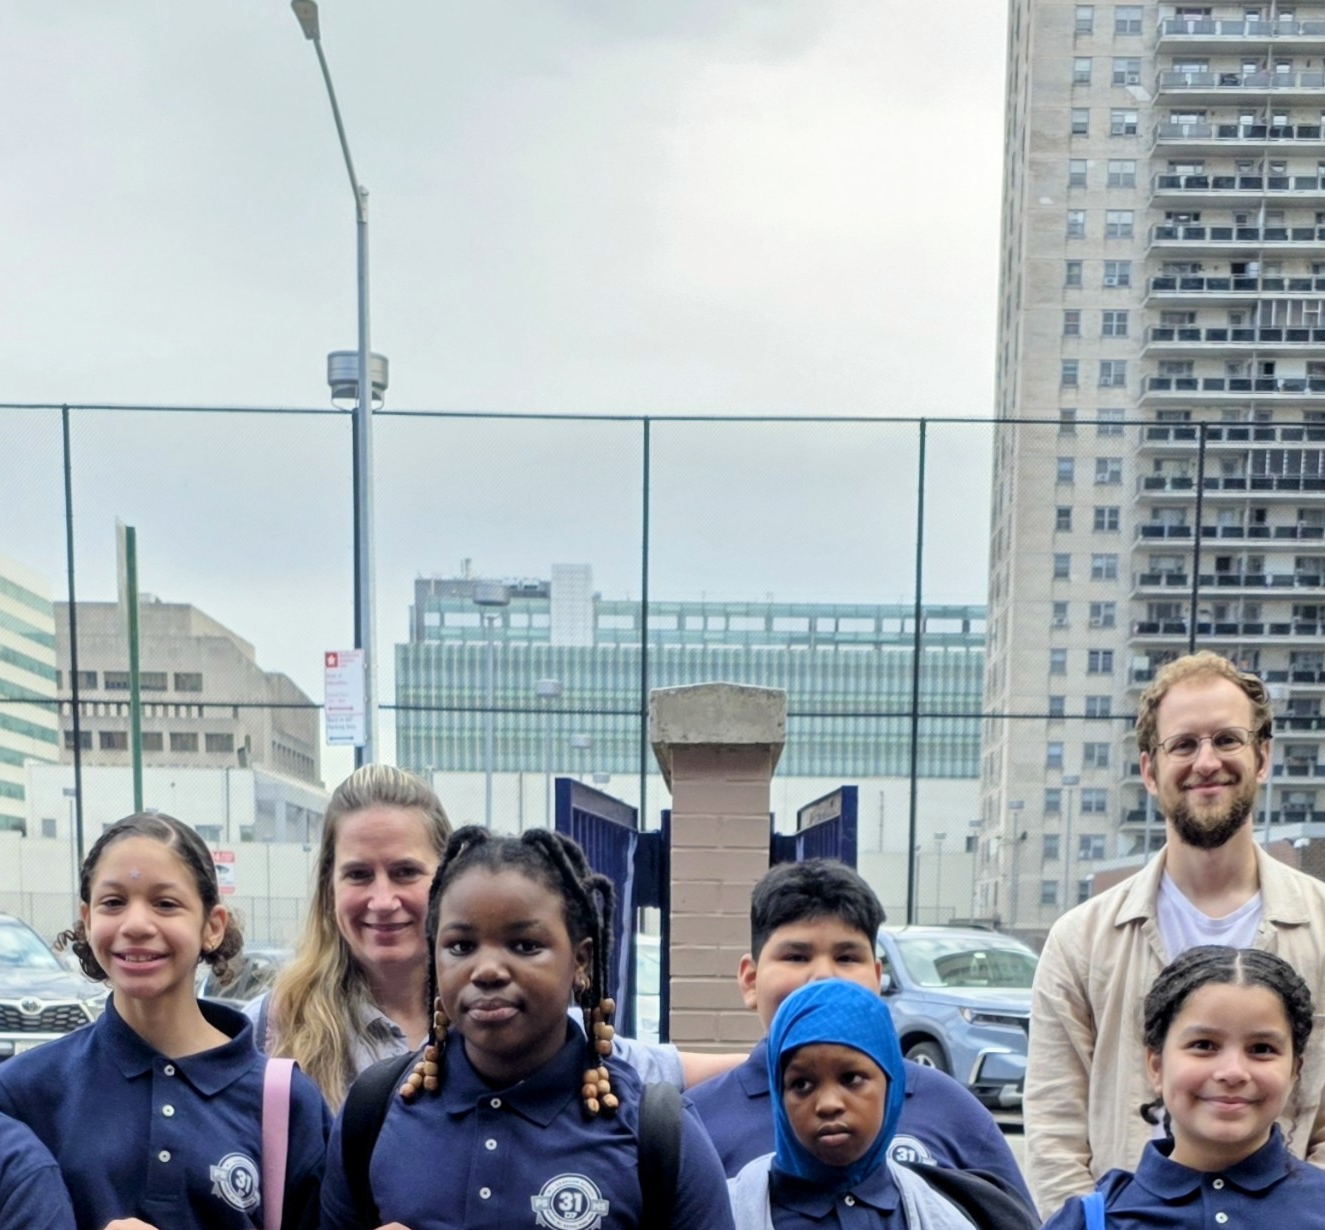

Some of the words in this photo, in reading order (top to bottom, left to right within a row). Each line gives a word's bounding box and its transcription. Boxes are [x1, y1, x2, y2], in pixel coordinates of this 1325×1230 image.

[895, 1146, 915, 1163] 31
[235, 1169, 252, 1193] 31
[559, 1191, 582, 1212] 31
